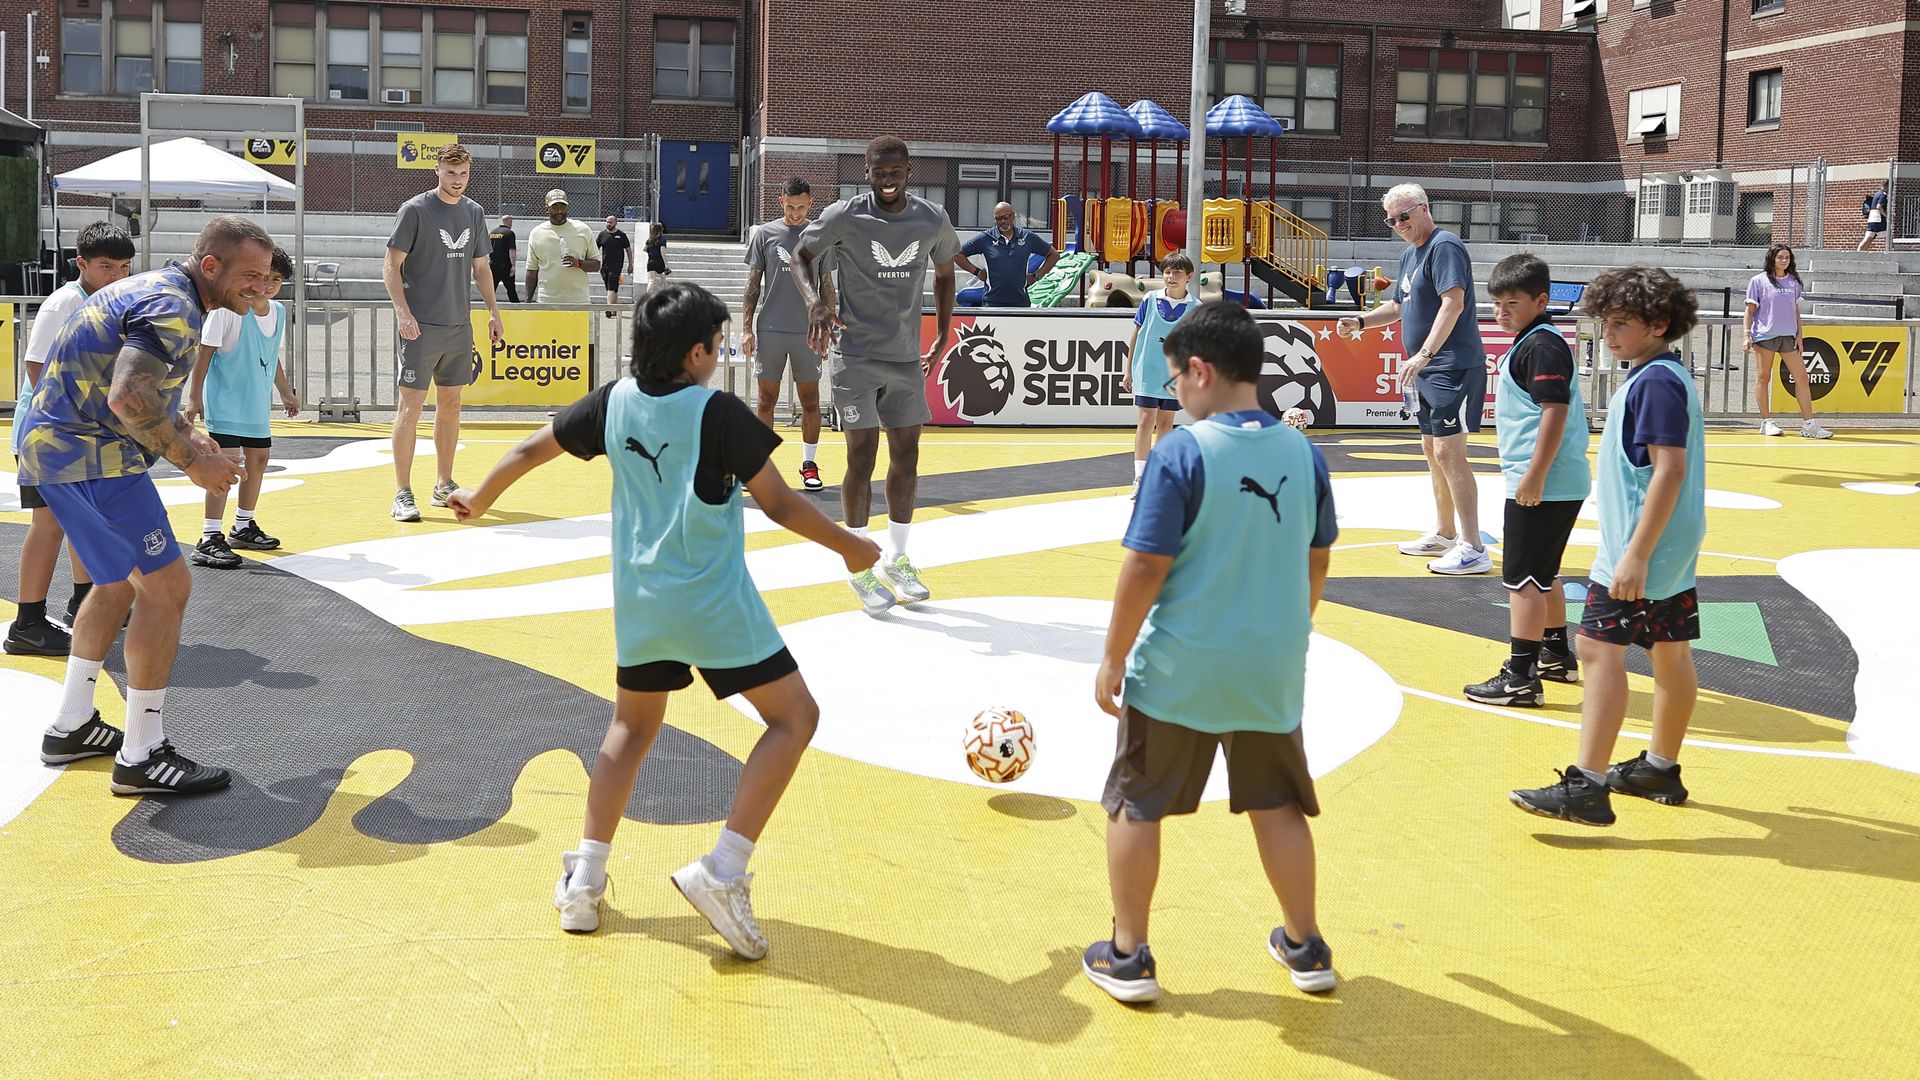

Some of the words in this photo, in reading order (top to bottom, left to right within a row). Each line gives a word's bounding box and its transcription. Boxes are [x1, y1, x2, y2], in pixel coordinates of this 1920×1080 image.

[421, 152, 438, 160] Lea
[544, 147, 561, 157] EA
[491, 339, 581, 359] Premier
[1023, 339, 1130, 372] SUM
[491, 360, 581, 386] League
[1788, 373, 1831, 384] SRTS
[1022, 373, 1134, 406] SERIE
[1366, 409, 1397, 417] Premier
